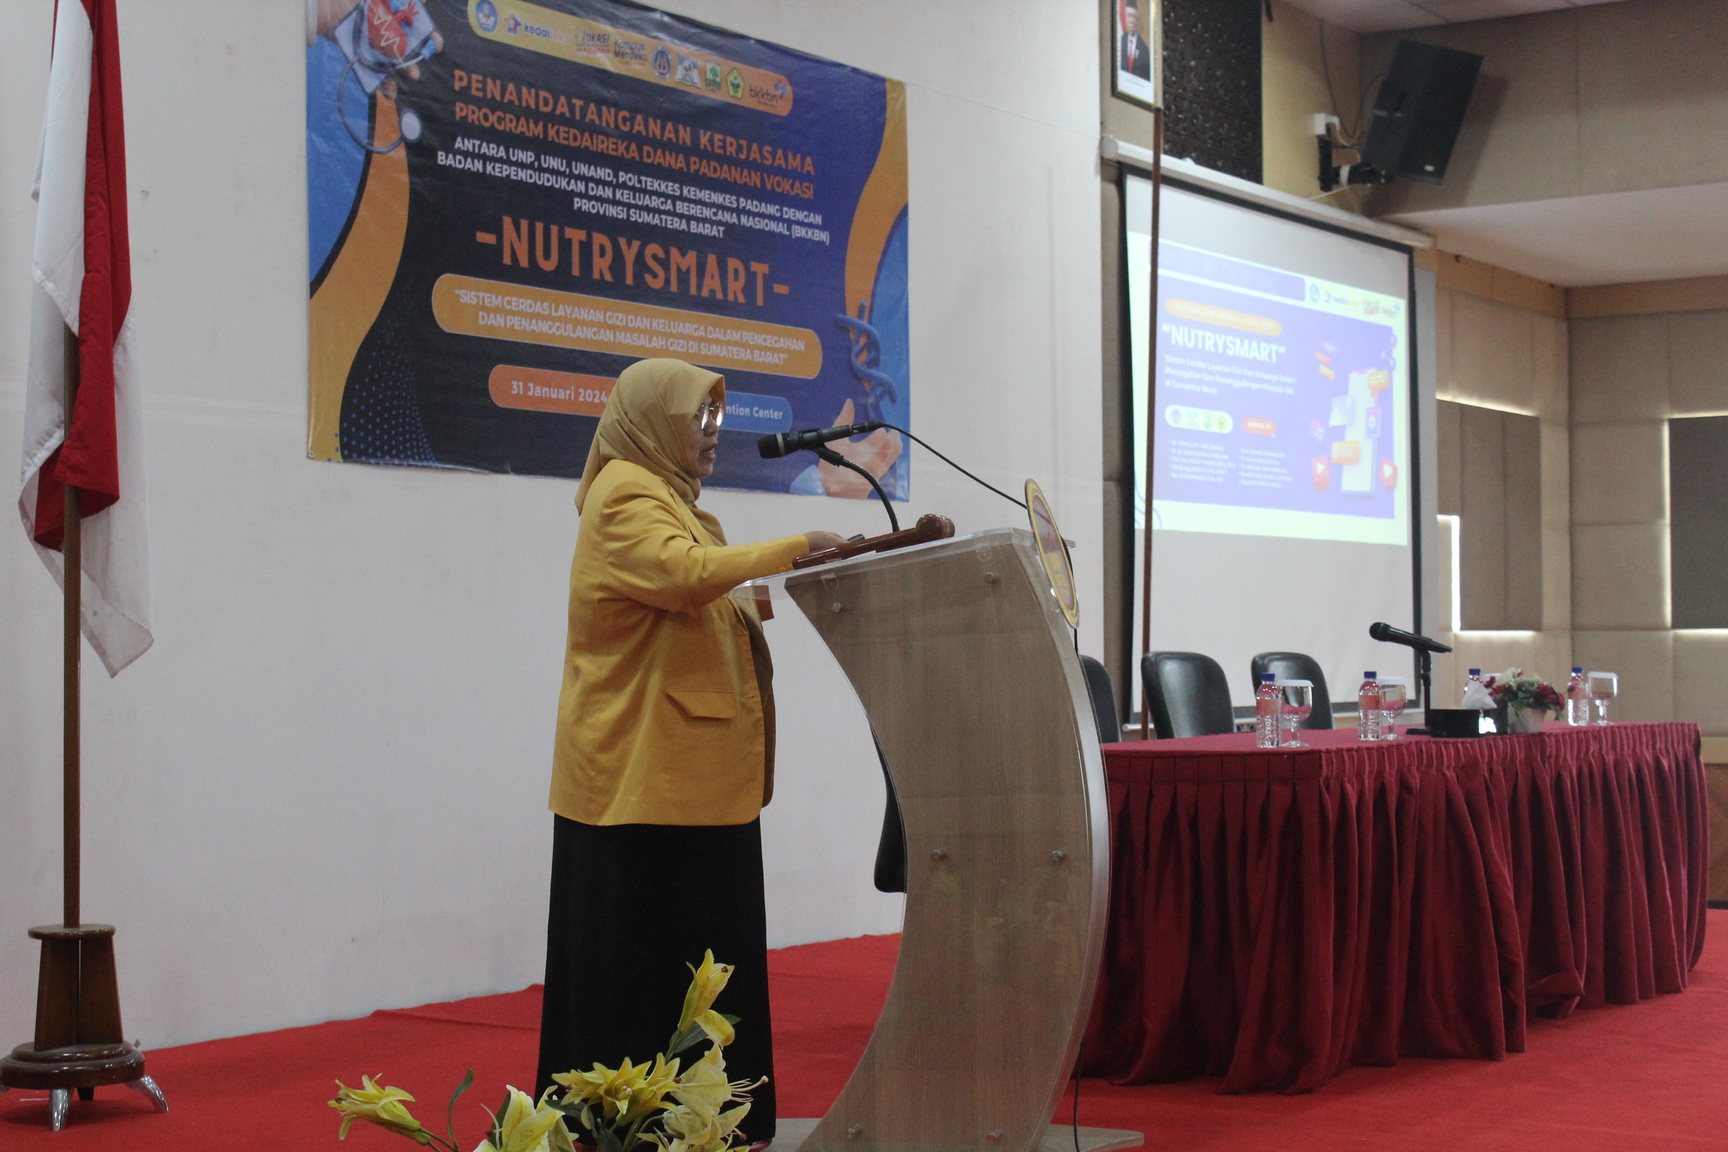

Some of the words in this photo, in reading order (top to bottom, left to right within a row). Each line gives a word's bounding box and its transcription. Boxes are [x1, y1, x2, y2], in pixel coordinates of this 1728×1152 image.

[454, 69, 691, 147] PENANDATANGANAN
[700, 129, 815, 176] KERJASAMA
[455, 102, 543, 139] PROGRAM
[548, 123, 639, 161] KEDAIREKA
[643, 145, 687, 172] DANA
[690, 156, 761, 188] PADANAN
[763, 173, 814, 199] VOKASI
[437, 151, 483, 173] BADAN
[486, 161, 585, 194] KEPENDUDUKAN
[588, 182, 613, 200] DAN
[615, 188, 674, 212] KELUARGA
[675, 201, 738, 225] BERENCANA
[740, 214, 790, 235] NASIONAL
[791, 224, 830, 246] (BKKBN)
[454, 136, 507, 159] ANTARA
[509, 148, 538, 168] UNP,
[541, 154, 569, 175] UNU,
[572, 161, 616, 184] UNAND,
[619, 171, 680, 196] POLTEKKES
[682, 185, 737, 208] KEMENKES
[740, 197, 781, 217] PADANG
[782, 207, 822, 226] DENGAN
[573, 197, 627, 220] PROVINSI
[629, 208, 688, 232] SUMATERA
[690, 220, 725, 238] BARAT
[478, 311, 505, 328] DAN
[506, 315, 614, 343] PENANGGULANGAN
[615, 330, 666, 349] MASALAH
[667, 338, 687, 352] GIZI
[688, 340, 699, 353] DI
[700, 343, 751, 361] SUMATERA
[503, 296, 549, 315] CERDAS
[551, 303, 604, 323] LAYANAN
[605, 310, 626, 327] GIZI
[627, 313, 650, 330] DAN
[651, 318, 706, 338] KELUARGA
[707, 326, 742, 343] DALAM
[742, 331, 805, 352] PENCEGAHAN
[511, 381, 523, 395] 31
[527, 383, 575, 400] Januari
[578, 388, 608, 404] 2024
[752, 406, 784, 420] Center
